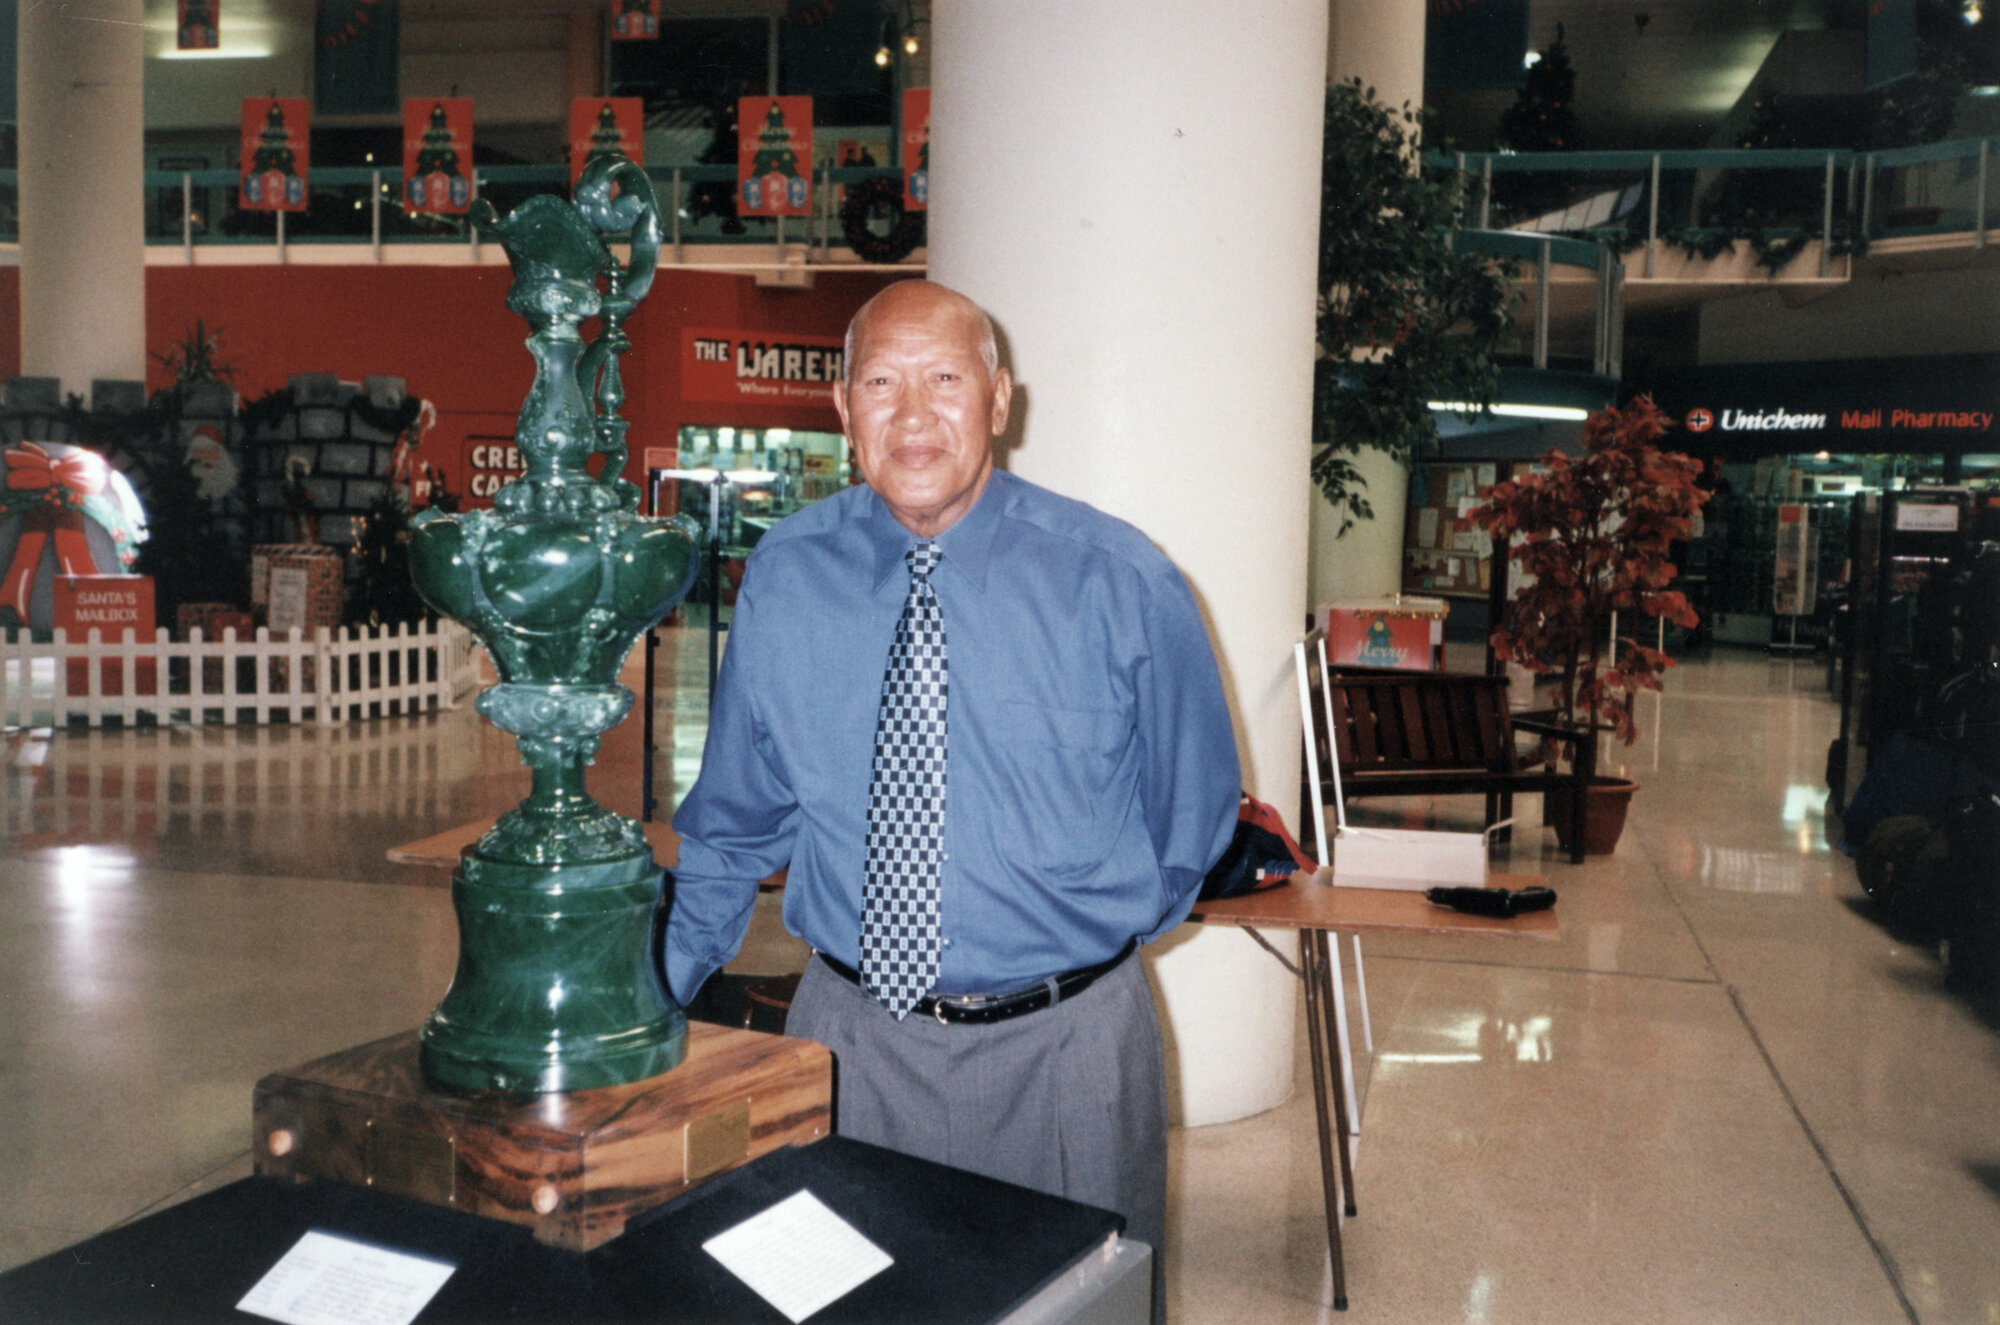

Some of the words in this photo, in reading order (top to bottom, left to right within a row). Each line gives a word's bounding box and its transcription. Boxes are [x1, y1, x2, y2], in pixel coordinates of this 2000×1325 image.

[693, 340, 730, 362] THE
[737, 345, 843, 382] WAREH
[1721, 407, 1827, 431] Unichem
[1841, 409, 1882, 429] Mall
[1891, 409, 1994, 432] Pharmacy
[77, 591, 137, 605] SANTA'S
[75, 608, 138, 622] MAILBOX
[1353, 639, 1409, 662] Merry
